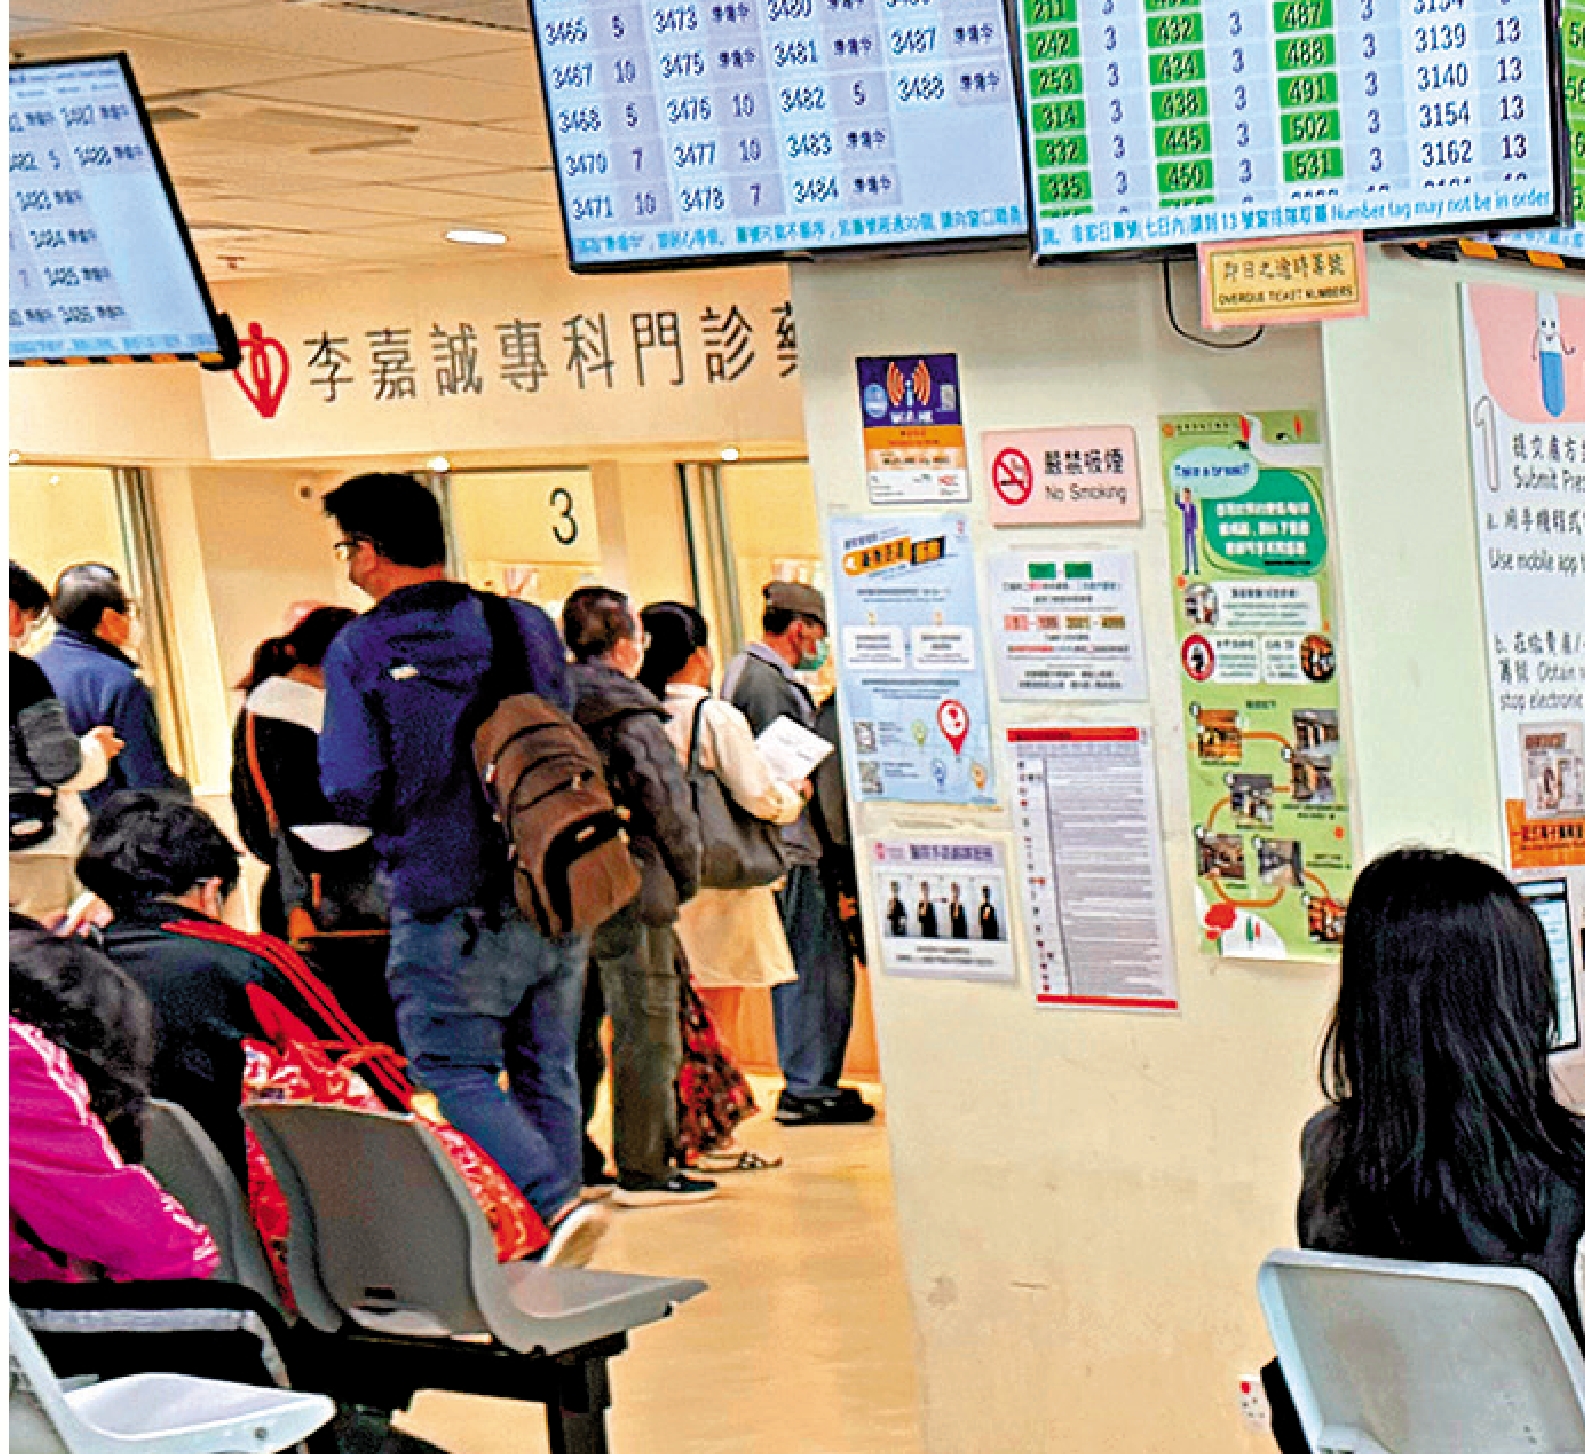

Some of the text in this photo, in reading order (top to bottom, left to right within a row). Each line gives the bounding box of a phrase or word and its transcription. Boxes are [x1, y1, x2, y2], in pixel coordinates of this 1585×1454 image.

[613, 16, 624, 37] 5
[1104, 11, 1521, 53] 3 3 3139 13
[614, 61, 635, 84] 10
[1107, 33, 1523, 91] 3 3 3 3140 13
[626, 80, 866, 127] 5 10 5
[1110, 71, 1524, 130] 3 3 491 3 3154 13
[632, 148, 643, 171] 7
[673, 140, 716, 168] 3477
[739, 138, 762, 163] 10
[1113, 109, 1528, 168] 3 3 502 3 3162 13
[1115, 147, 1384, 196] 3 3 3
[571, 195, 613, 221] 3471
[634, 192, 656, 216] 10
[750, 181, 762, 206] 7
[1330, 188, 1550, 225] Number tag may not be in order
[1305, 285, 1353, 301] NUMBERS
[1046, 483, 1128, 504] No Smoking
[1513, 465, 1558, 490] Submit
[549, 486, 580, 546] 3
[1489, 547, 1513, 571] Use
[1517, 549, 1553, 571] mobile
